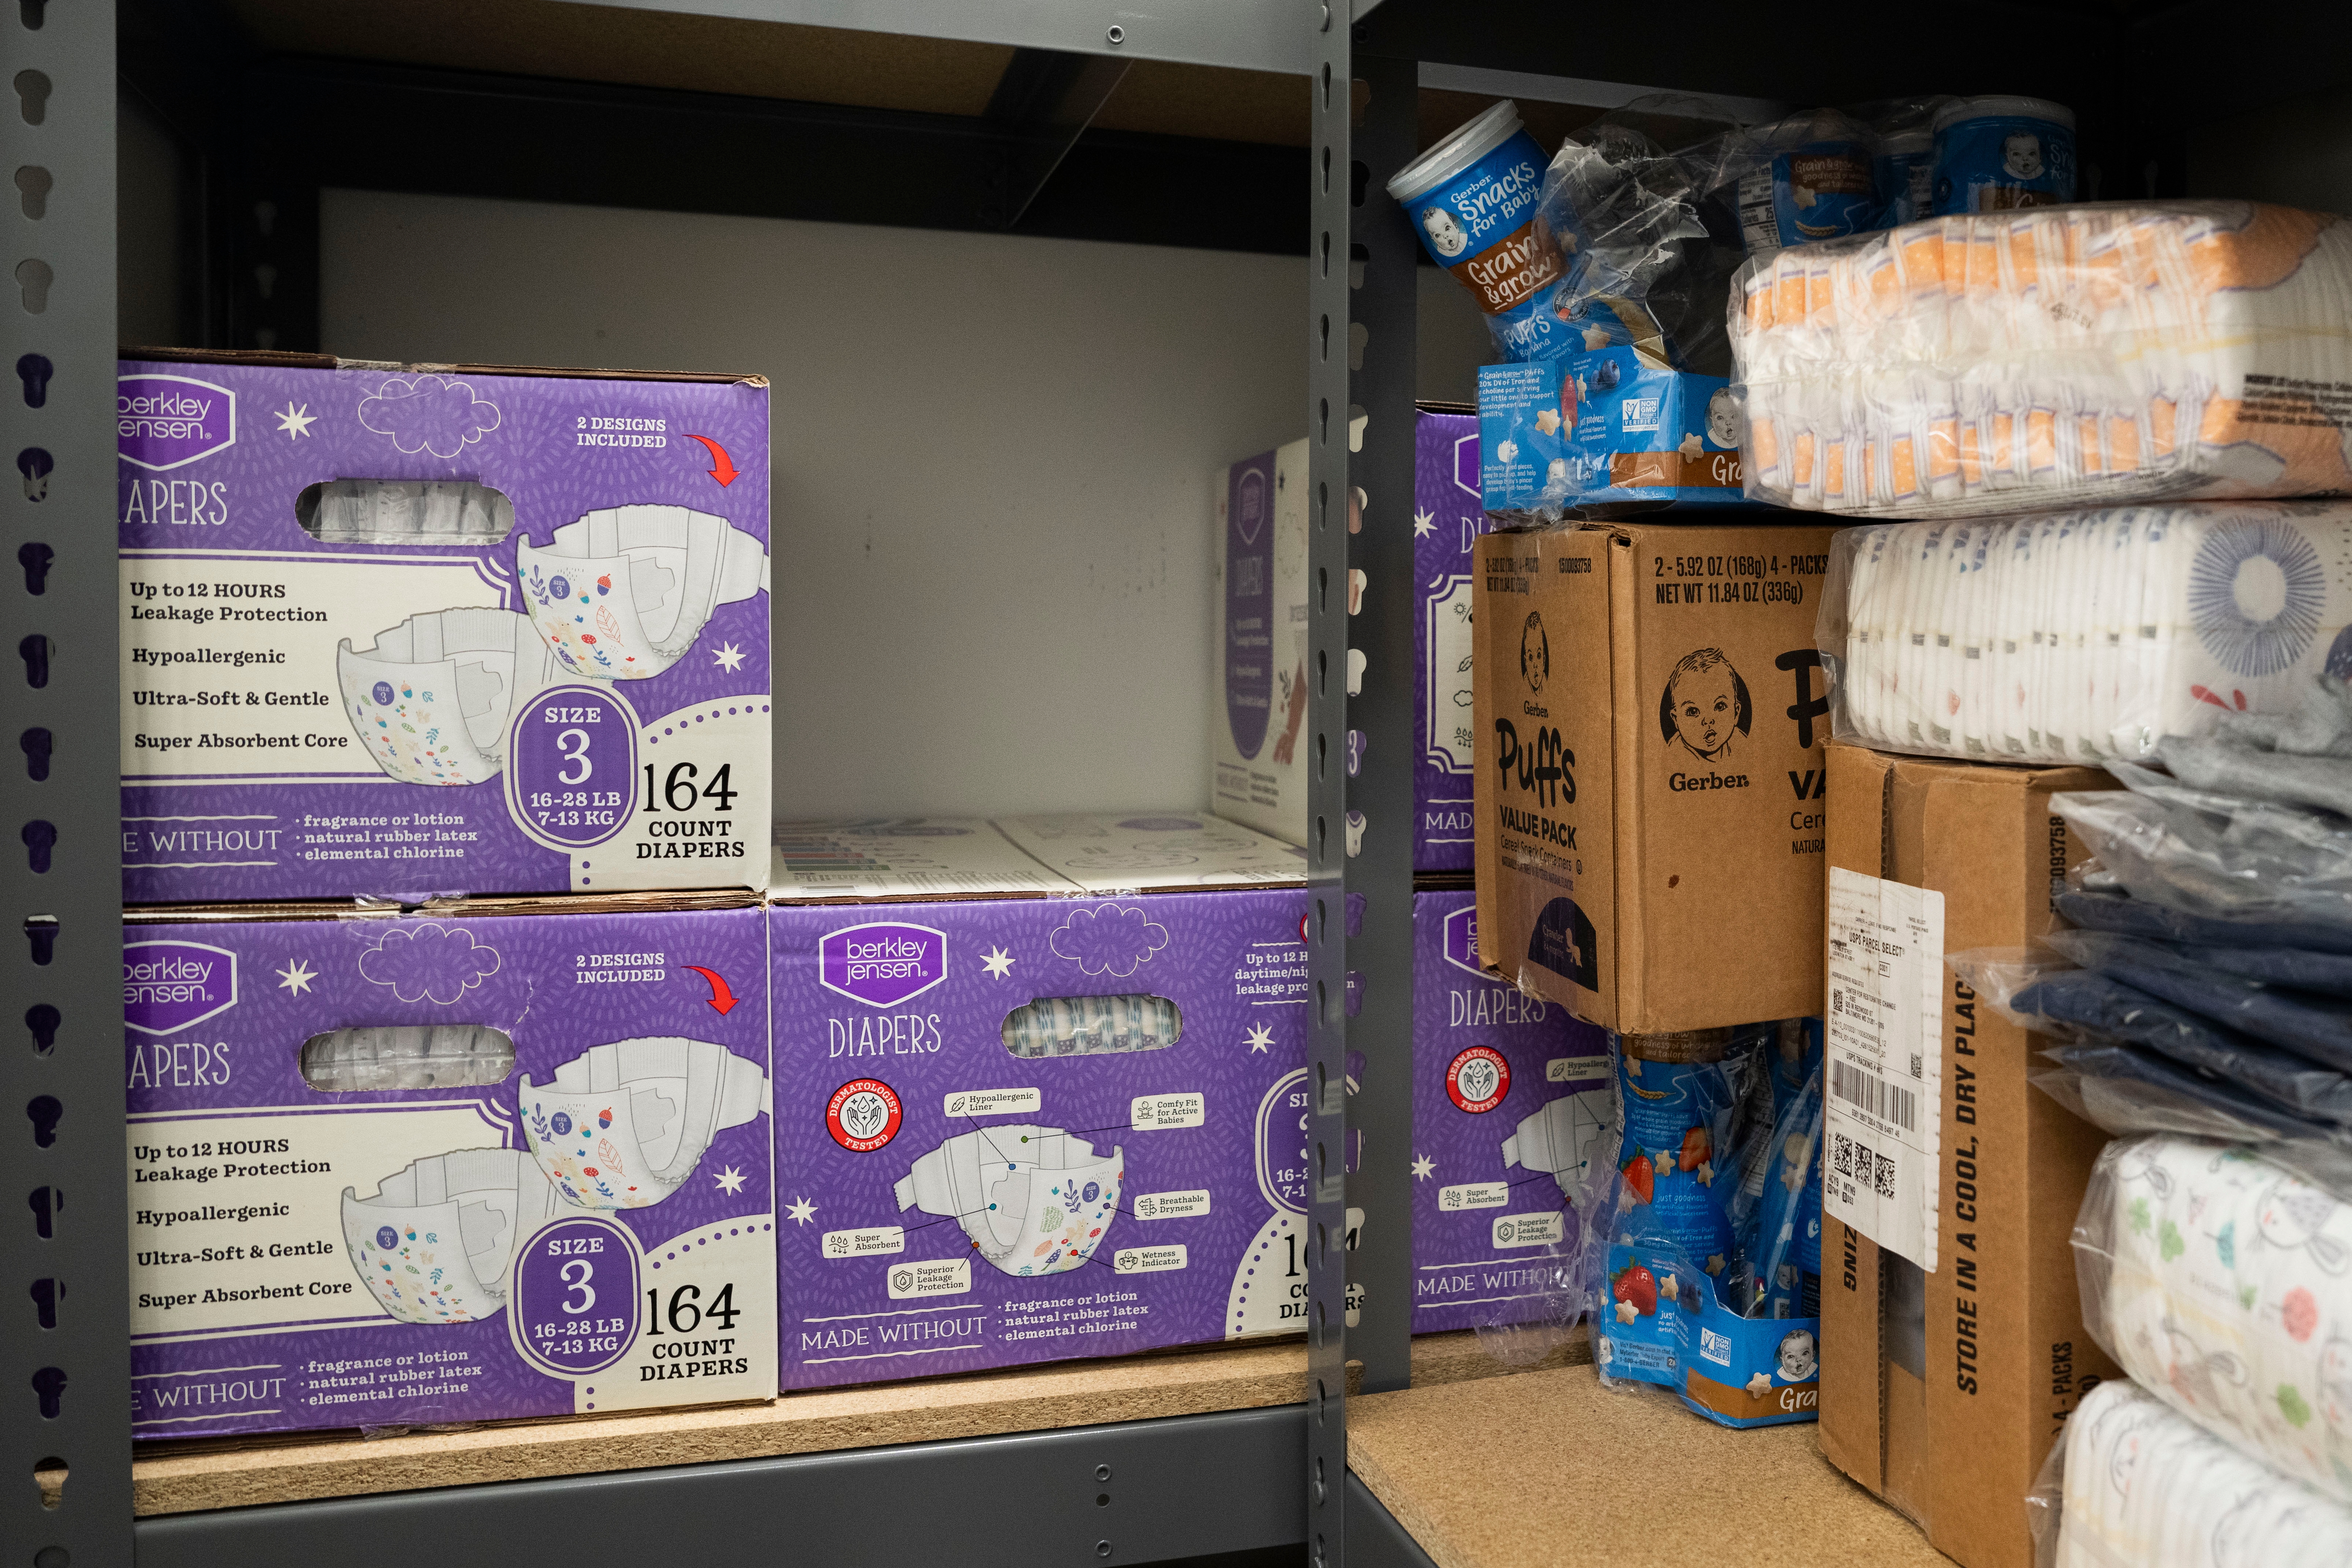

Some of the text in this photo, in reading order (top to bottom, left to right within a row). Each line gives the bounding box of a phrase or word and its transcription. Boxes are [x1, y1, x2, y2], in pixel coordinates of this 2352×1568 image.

[1458, 162, 1535, 221] Snacks
[1471, 184, 1540, 237] for Baby
[1468, 236, 1538, 285] Grain
[118, 419, 204, 439] ensen
[578, 417, 666, 432] 2 DESIGNS
[577, 433, 667, 448] INCLUDED
[120, 479, 227, 525] APERS
[1558, 557, 1591, 574] 1500093758
[1655, 557, 1664, 577] 2
[1676, 557, 1703, 576] 5.92
[1707, 556, 1723, 576] OZ
[1726, 555, 1767, 579] (168g)
[1770, 556, 1778, 575] 4
[1791, 555, 1829, 575] PACKS
[130, 582, 286, 599] Up to 12 HOURS
[556, 586, 563, 597] 3
[1656, 580, 1803, 605] NET WT 11.84 OZ (336g)
[131, 605, 328, 624] Leakage Protection
[132, 648, 285, 667] Hypoallergenic
[133, 690, 329, 706] Ultra-Soft & Gentle
[545, 707, 601, 723] SIZE
[135, 733, 348, 751] Super Absorbent Core
[556, 728, 593, 785] 3
[1495, 718, 1576, 809] Puffs
[643, 762, 738, 813] 164
[530, 792, 621, 807] 16-28 LB
[303, 813, 465, 829] fragrance or lotion
[538, 811, 615, 826] 7-13 KG
[1425, 812, 1473, 830] MAD
[1500, 804, 1577, 851] VALUE PACK
[305, 829, 478, 844] natural rubber latex
[648, 821, 732, 837] COUNT
[149, 829, 282, 851] WITHOUT
[305, 847, 464, 860] elemental chlorine
[636, 841, 745, 859] DIAPERS
[847, 937, 927, 961] berkley
[1849, 932, 1861, 945] USPS
[1862, 936, 1880, 952] PARCEL
[1882, 942, 1902, 957] SELECT
[576, 953, 665, 967] 2 DESIGNS
[1246, 952, 1296, 965] Up to 12
[576, 969, 665, 984] INCLUDED
[1236, 983, 1285, 996] leakage
[1846, 986, 1856, 996] CENTER
[1882, 1001, 1896, 1011] CHANGE
[829, 1014, 941, 1058] DIAPERS
[1448, 1049, 1507, 1081] DERMATOLOGIST
[1846, 1052, 1873, 1071] USPS TRACKING
[829, 1082, 899, 1118] DERMATOLOGIST
[969, 1093, 1034, 1105] Hypoallergenic
[1955, 1064, 1976, 1125] DRY
[969, 1103, 993, 1111] Liner
[1157, 1099, 1198, 1110] Comfy Fit
[1157, 1107, 1198, 1117] for Active
[1461, 1097, 1499, 1112] TESTED
[1157, 1115, 1184, 1125] Babies
[134, 1139, 290, 1162] Up to 12 HOURS
[844, 1133, 888, 1150] TESTED
[135, 1159, 331, 1183] Leakage Protection
[1955, 1136, 1979, 1222] COOL,
[1160, 1195, 1204, 1205] Breathable
[1467, 1188, 1488, 1196] Super
[1467, 1194, 1505, 1204] Absorbent
[1674, 1194, 1706, 1203] goodness
[136, 1202, 290, 1227] Hypoallergenic
[1160, 1204, 1193, 1214] Dryness
[548, 1237, 604, 1256] SIZE
[855, 1235, 881, 1244] Super
[855, 1240, 901, 1251] Absorbent
[1956, 1233, 1976, 1252] A
[137, 1240, 334, 1266] Ultra-Soft & Gentle
[1142, 1250, 1176, 1259] Wetness
[1142, 1257, 1180, 1268] Indicator
[917, 1266, 955, 1275] Superior
[917, 1274, 952, 1283] Leakage
[1956, 1258, 1976, 1292] IN
[560, 1259, 596, 1314] 3
[917, 1280, 964, 1291] Protection
[1418, 1275, 1475, 1296] MADE
[138, 1281, 352, 1310] Super Absorbent Core
[646, 1283, 741, 1336] 164
[535, 1318, 625, 1338] 16-28 LB
[802, 1317, 987, 1351] MADE WITHOUT
[542, 1336, 619, 1356] 7-13 KG
[652, 1338, 735, 1359] COUNT
[1956, 1297, 1977, 1395] STORE
[640, 1357, 748, 1381] DIAPERS
[2052, 1341, 2072, 1394] PACKS
[153, 1378, 287, 1408] WITHOUT
[1780, 1388, 1817, 1412] Gra
